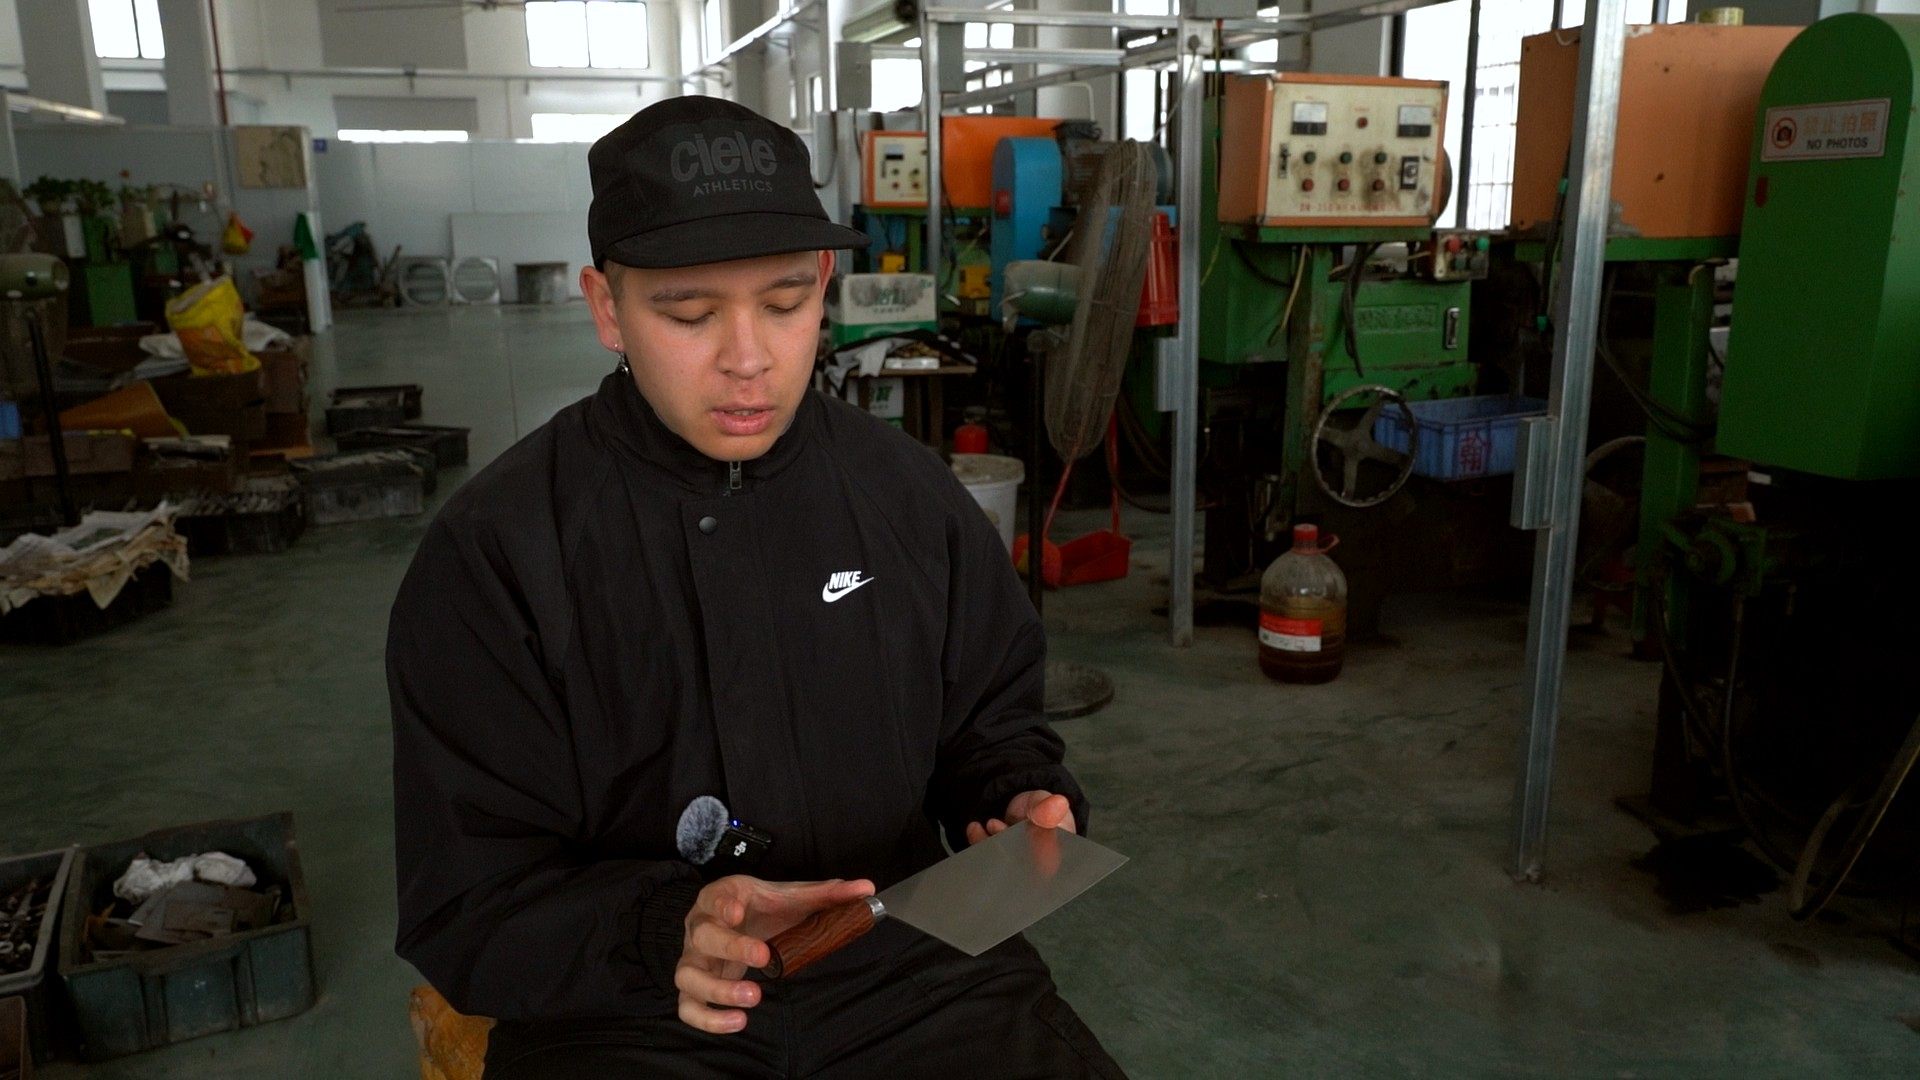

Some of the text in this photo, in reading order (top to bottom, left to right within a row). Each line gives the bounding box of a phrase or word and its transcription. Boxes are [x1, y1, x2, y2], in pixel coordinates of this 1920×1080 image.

[1806, 136, 1869, 150] NO PHOTOS
[669, 129, 778, 183] ciele
[692, 178, 774, 197] ATHLETICS
[828, 570, 862, 590] NIKE
